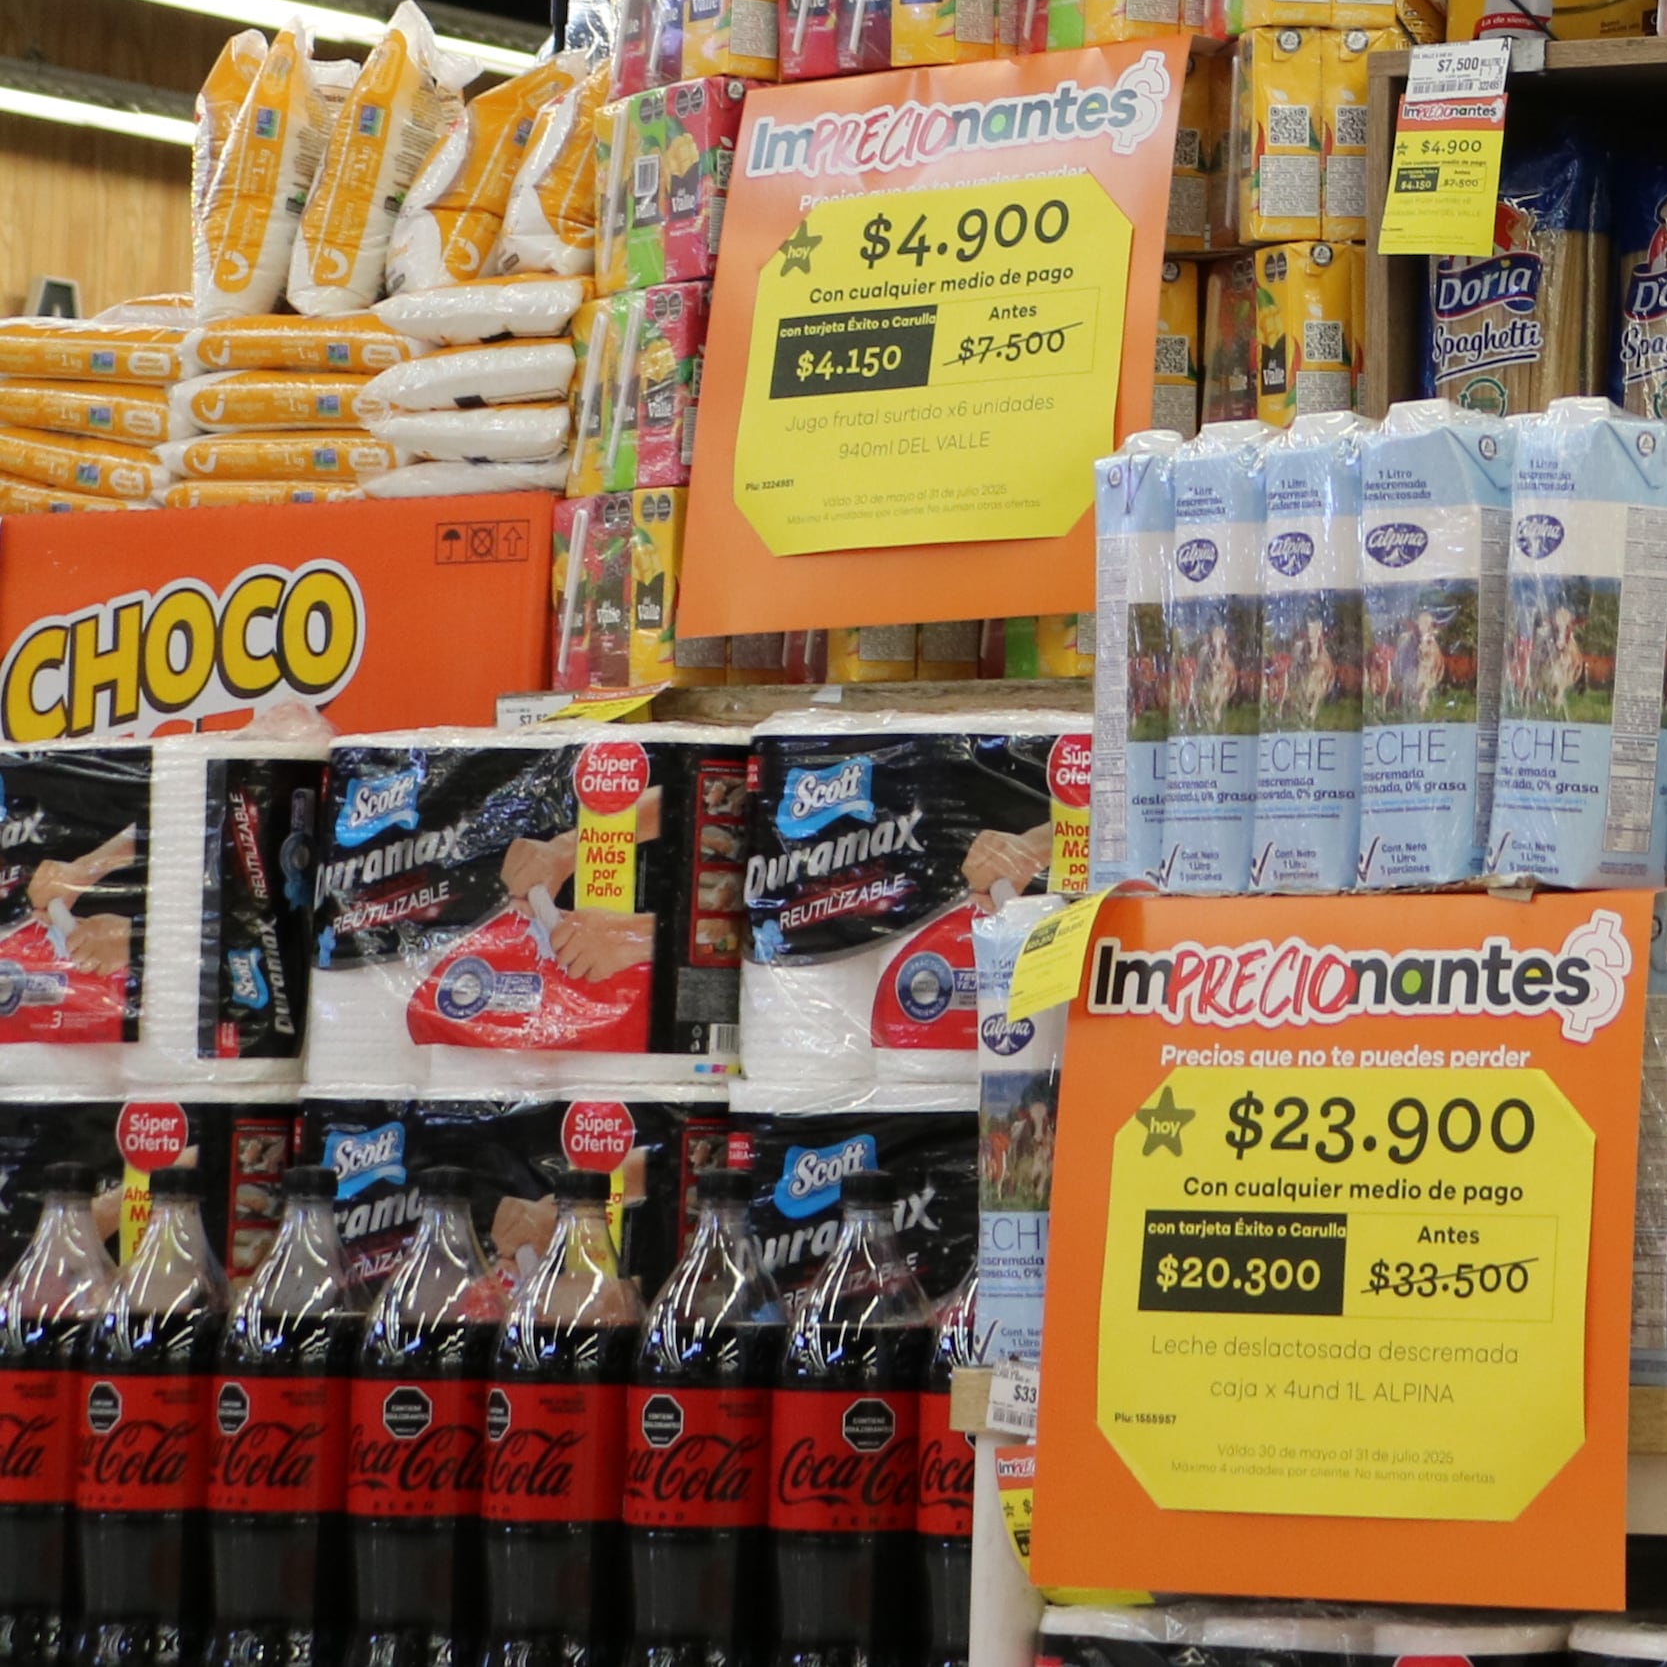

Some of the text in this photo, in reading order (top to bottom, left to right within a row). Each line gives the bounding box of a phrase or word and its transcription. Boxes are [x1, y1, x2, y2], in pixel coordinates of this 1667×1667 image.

[1437, 58, 1479, 73] $7,500
[1421, 140, 1482, 154] $4.900
[860, 199, 1069, 269] $4.900
[1439, 258, 1532, 312] Doria
[989, 305, 1037, 320] Antes
[796, 329, 1064, 381] $4.150 $7.500
[1432, 320, 1544, 364] Spaghetti
[786, 416, 828, 433] Jugo
[833, 410, 878, 427] frutal
[884, 403, 942, 422] surtido
[974, 395, 1054, 416] unidades
[839, 431, 990, 460] 940ml DEL VALLE
[1, 558, 365, 743] CHOCO
[585, 754, 638, 774] Súper
[348, 771, 414, 823] Scott
[580, 773, 639, 794] Oferta
[1160, 1044, 1531, 1069] Precios que no te puedes perder
[1149, 1089, 1536, 1164] hoy $23.900
[1183, 1177, 1523, 1206] Con cualquier medio de pago
[1148, 1217, 1347, 1239] con tarjeta Éxito o Carulla
[1417, 1225, 1480, 1244] Antes
[1156, 1253, 1529, 1298] $20.300 $33.500
[1151, 1335, 1519, 1364] Leche deslactosada descremada
[1210, 1379, 1454, 1403] caja x 4und 1L ALPINA
